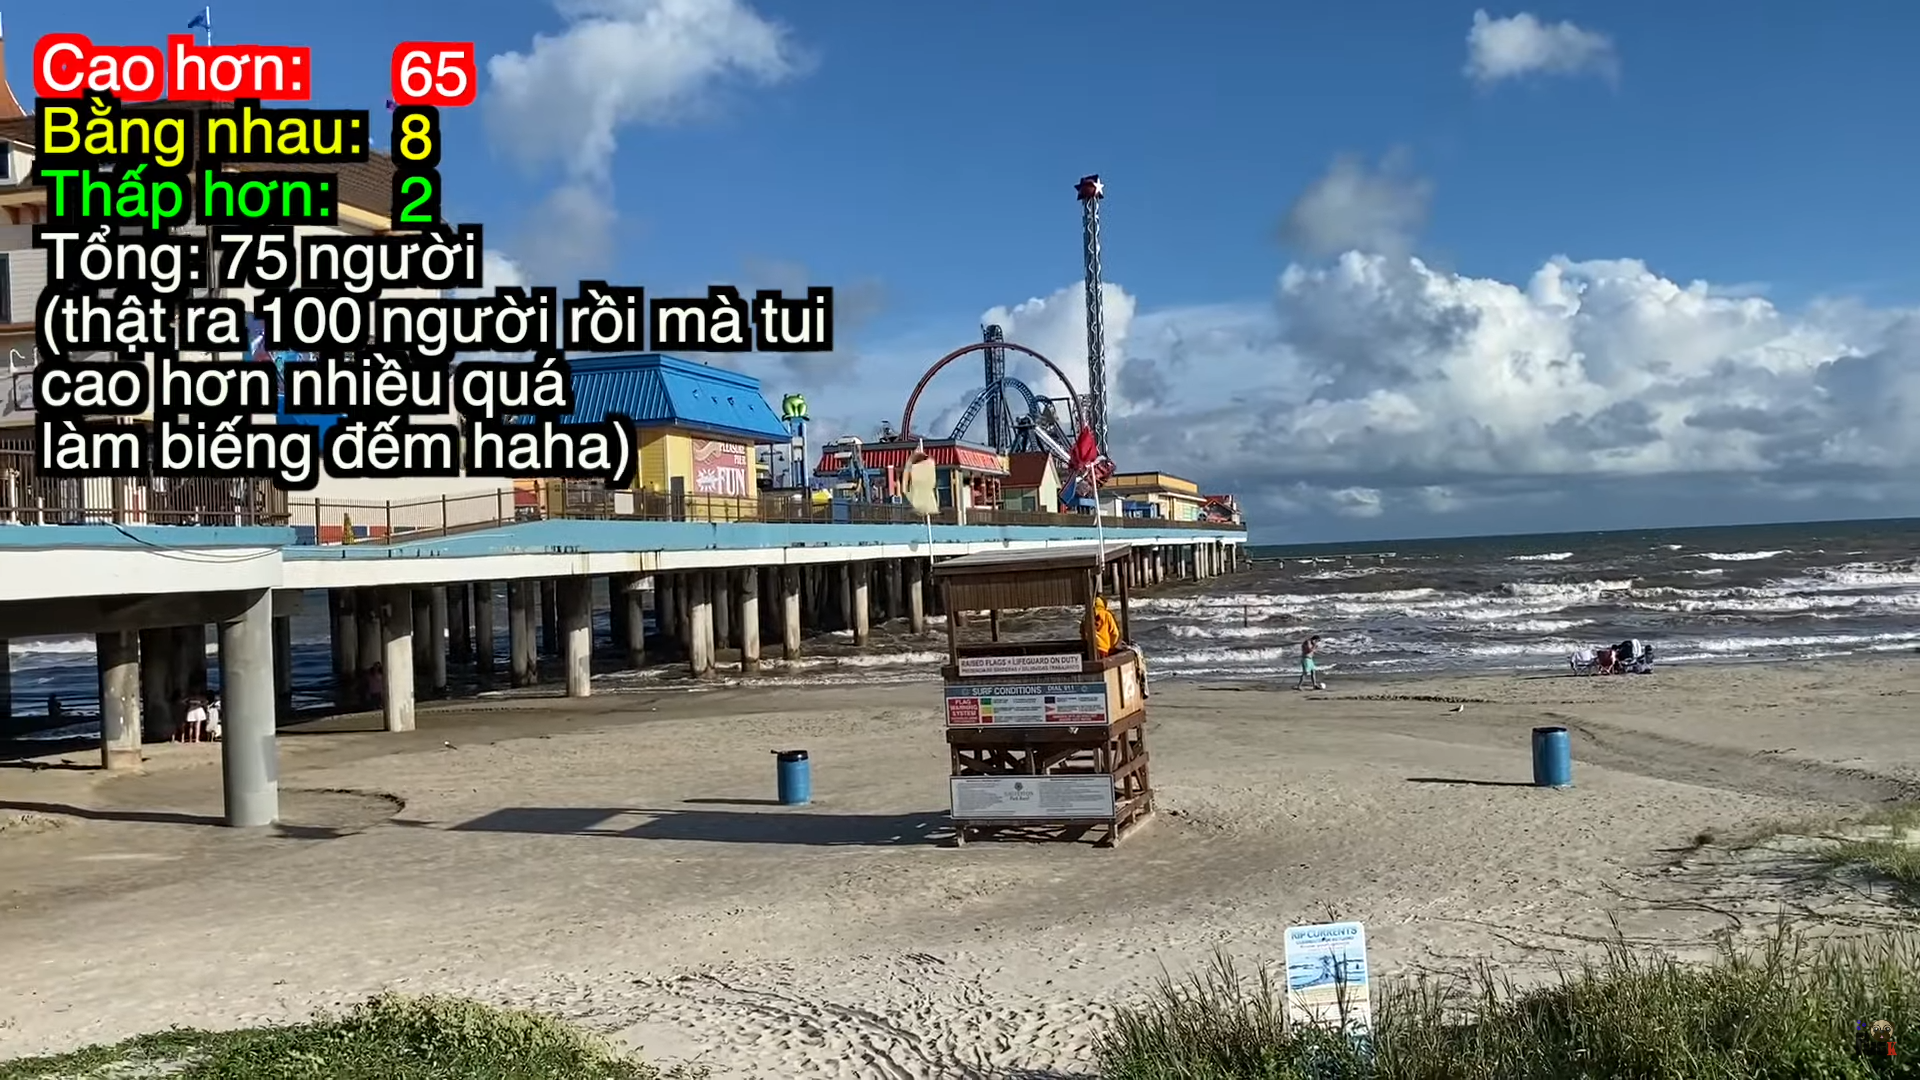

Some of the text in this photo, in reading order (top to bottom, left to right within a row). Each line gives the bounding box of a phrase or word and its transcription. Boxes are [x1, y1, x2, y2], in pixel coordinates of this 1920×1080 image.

[717, 466, 747, 497] FUN
[961, 659, 984, 667] RAISED
[1012, 657, 1049, 666] LIFEGUARD
[1050, 656, 1060, 664] ON
[1061, 656, 1079, 664] DUTY
[972, 688, 992, 696] SURF
[994, 686, 1042, 695] CONDITIONS
[1291, 928, 1358, 940] RIP CURRENTS
